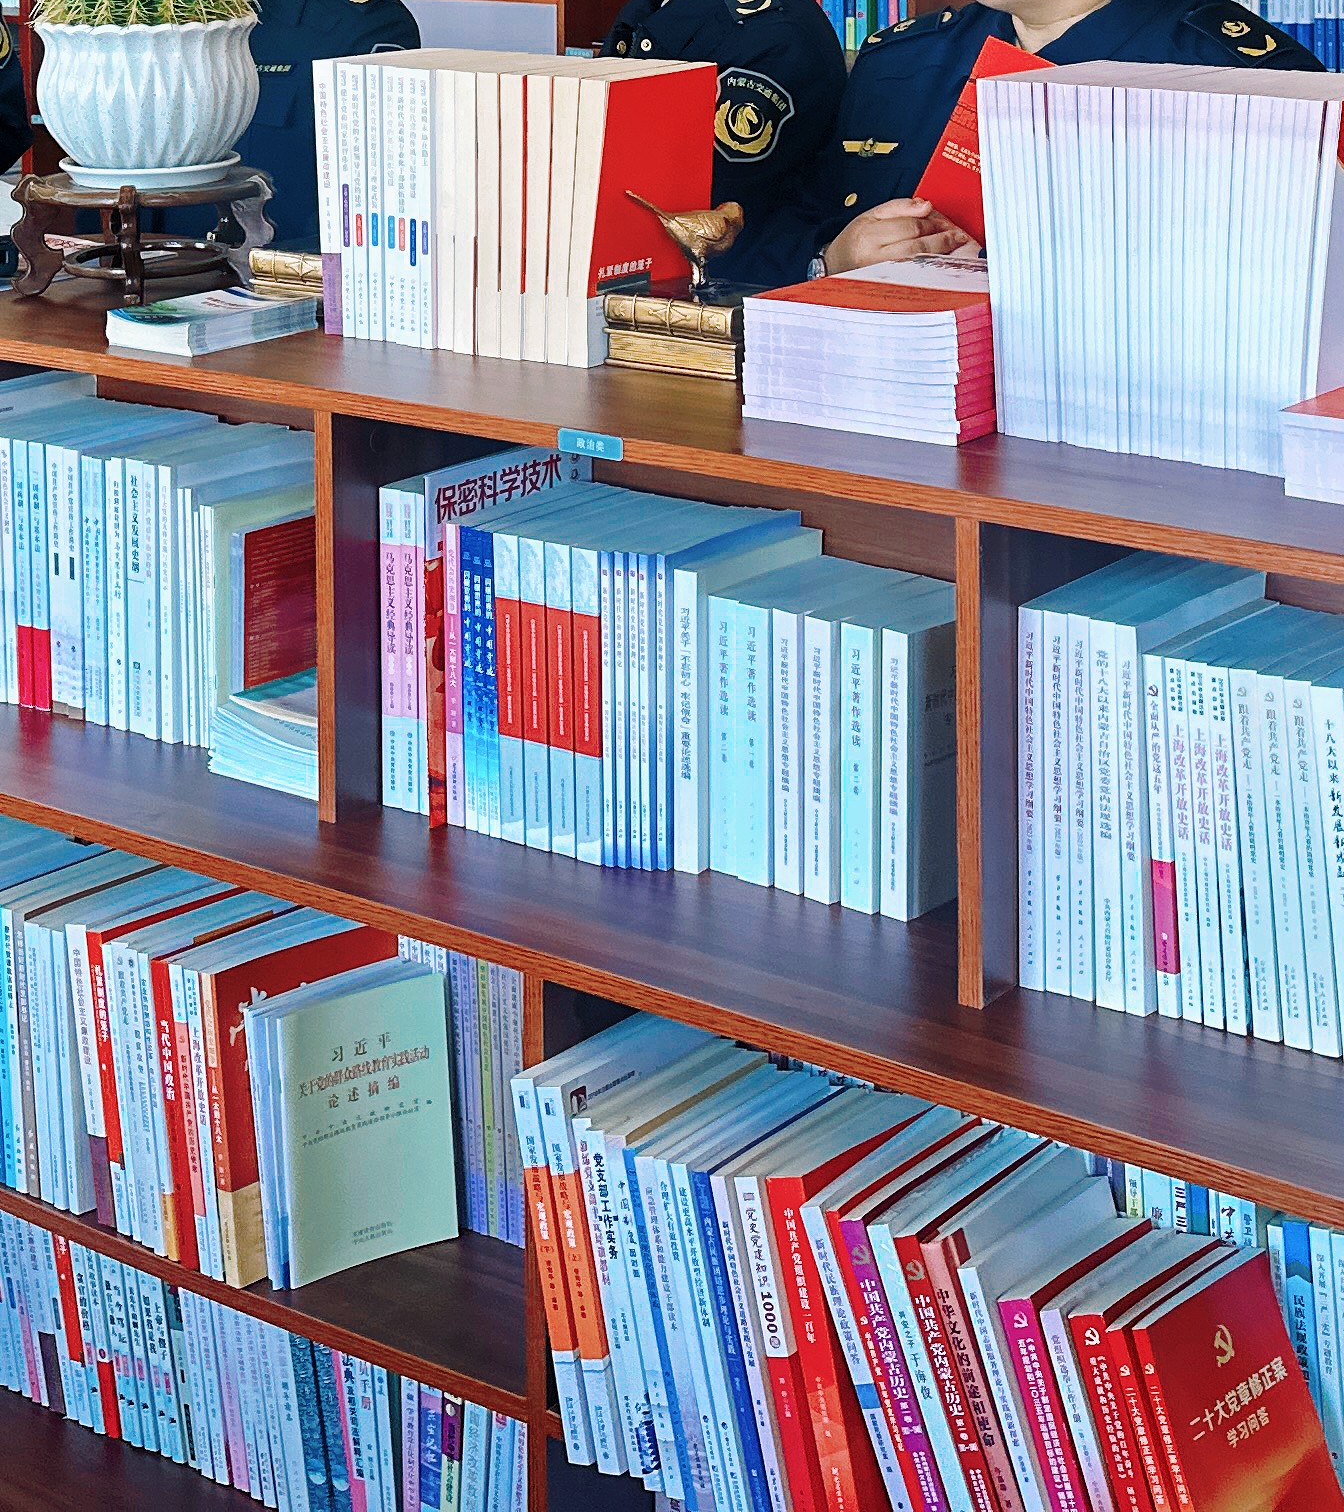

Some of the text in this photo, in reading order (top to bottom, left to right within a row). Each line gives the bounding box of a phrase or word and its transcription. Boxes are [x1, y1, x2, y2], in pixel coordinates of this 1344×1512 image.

[434, 453, 563, 524] 保密科学技术
[851, 648, 862, 748] 习近平著作选读
[1172, 723, 1190, 842] 上海改革开放史话
[1193, 727, 1211, 846] 上海改革开放史话
[1214, 732, 1233, 853] 上海改革开放史话
[331, 1031, 392, 1063] 习近平
[745, 1206, 771, 1288] 党史党建知识
[859, 1278, 910, 1400] 中国共产党内蒙古历史
[915, 1293, 965, 1418] 中国共产党内蒙古历史
[936, 1288, 996, 1448] 中华文化的前途和使命
[1189, 1355, 1289, 1441] 二十大党章修正案
[1225, 1406, 1271, 1449] 学习问答
